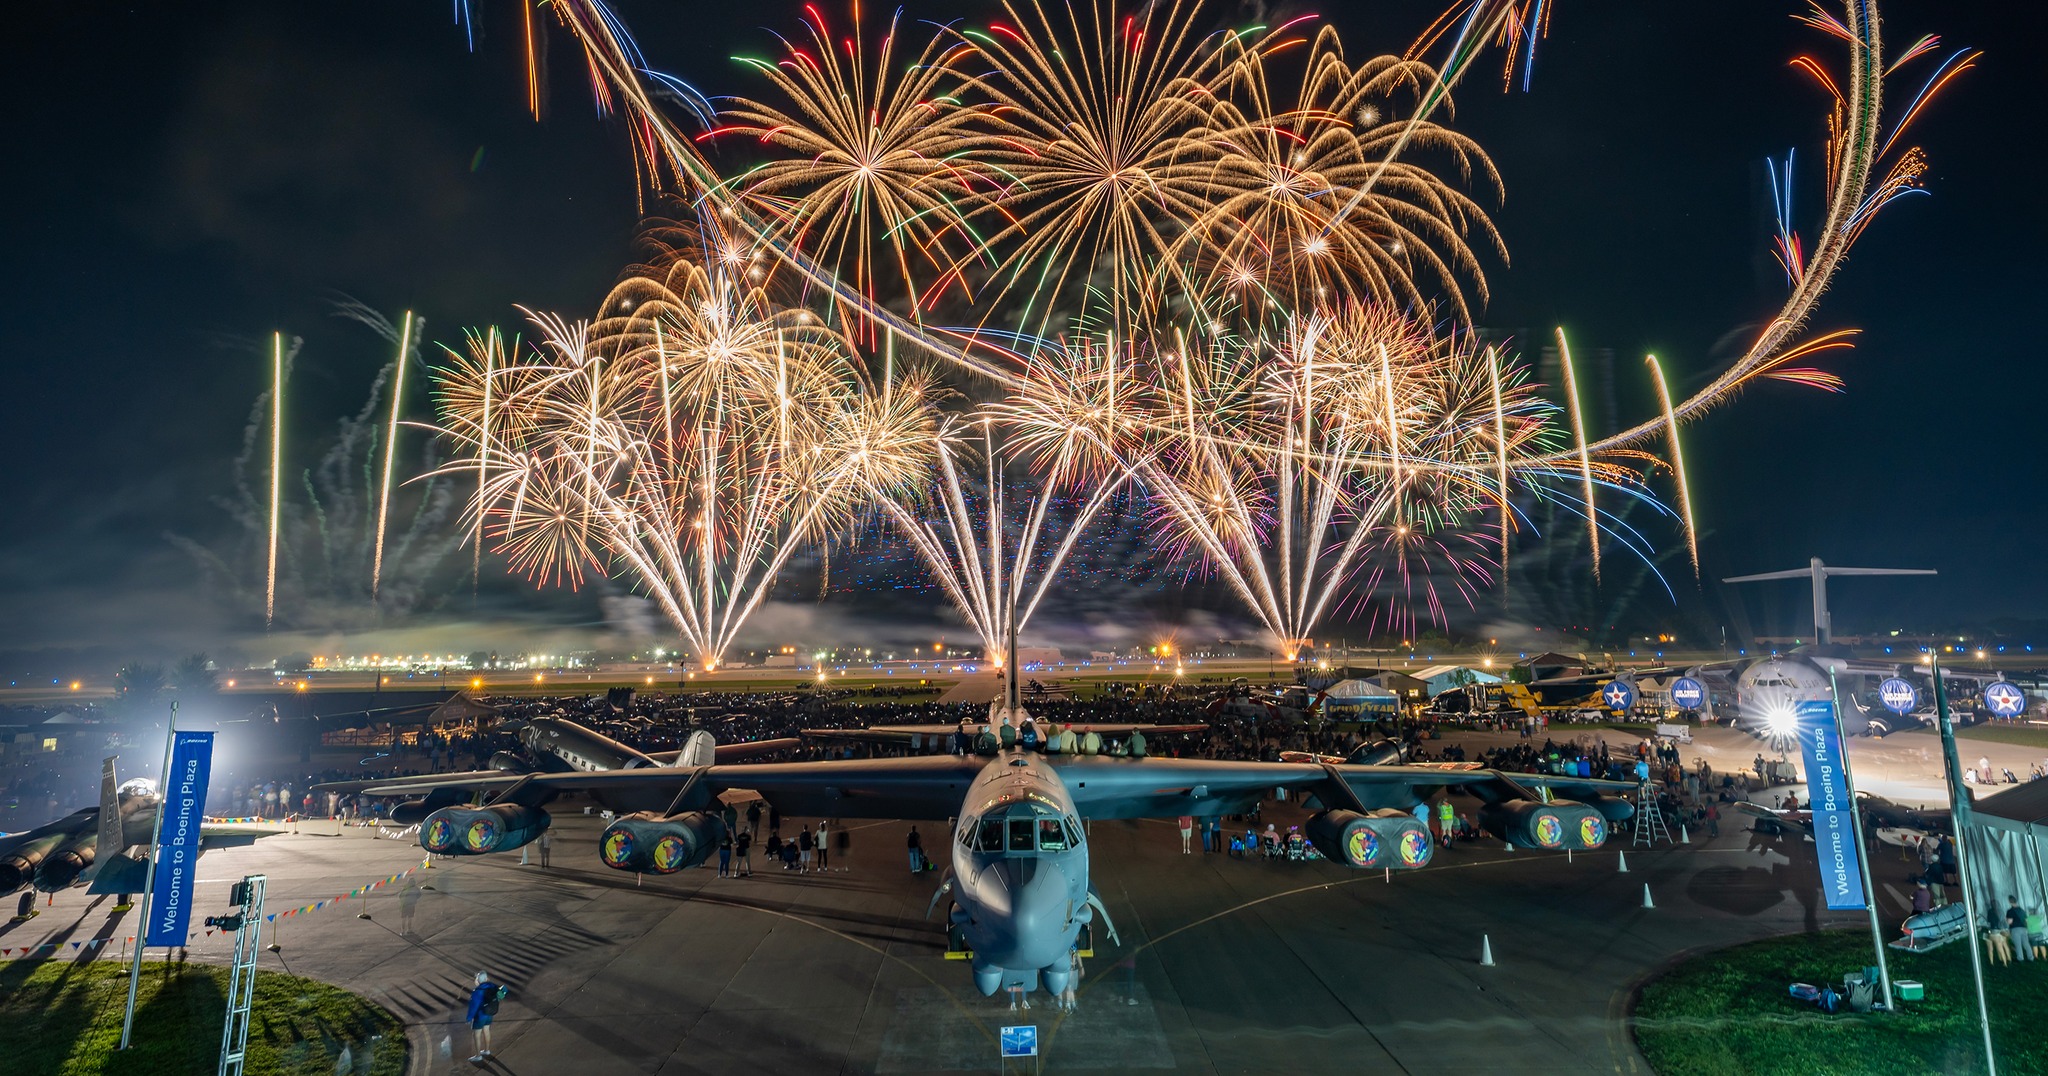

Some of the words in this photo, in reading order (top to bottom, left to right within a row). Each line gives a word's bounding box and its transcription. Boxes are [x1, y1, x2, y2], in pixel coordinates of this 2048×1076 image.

[1329, 702, 1395, 713] GOODYEAR
[1815, 728, 1828, 762] Plaza
[181, 759, 197, 794] Plaza
[1821, 765, 1836, 811] Boeing
[172, 798, 194, 846] Boeing
[1828, 815, 1839, 829] to
[173, 850, 184, 865] to
[1832, 832, 1849, 896] Welcome
[162, 867, 182, 933] Welcome
